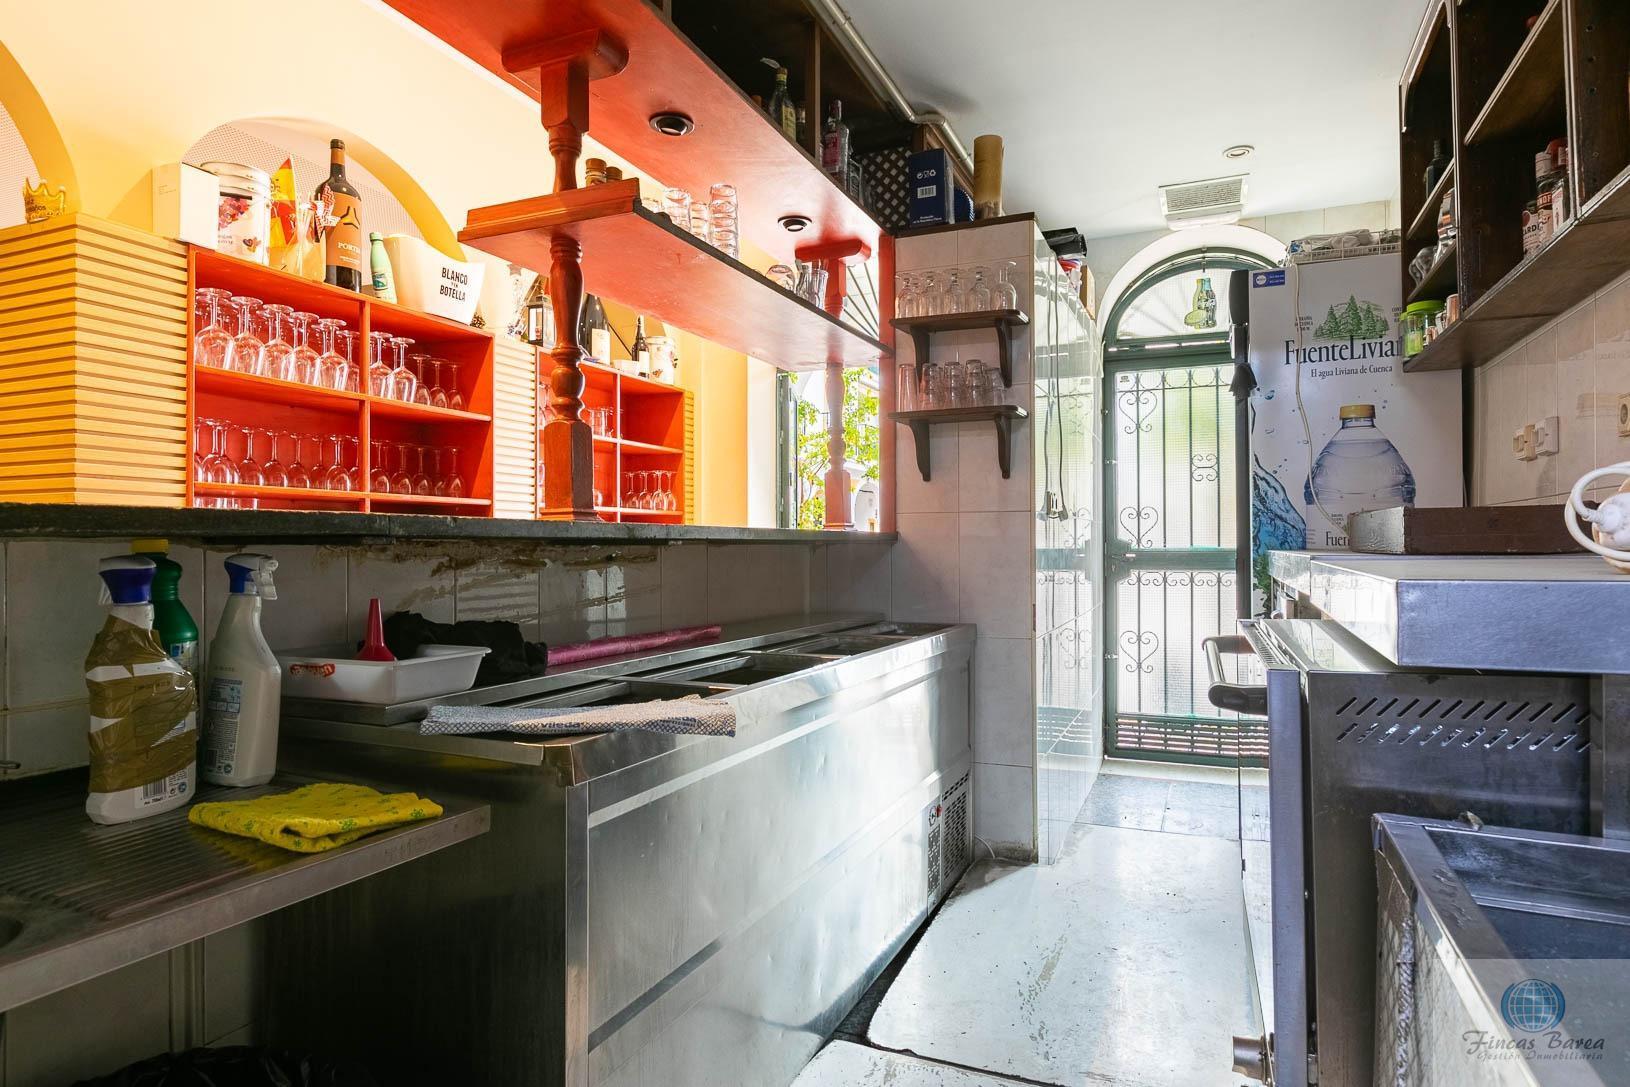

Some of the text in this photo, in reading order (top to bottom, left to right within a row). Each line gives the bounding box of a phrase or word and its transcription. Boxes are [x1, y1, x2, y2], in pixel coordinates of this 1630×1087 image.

[441, 267, 468, 285] BLANCO
[439, 284, 466, 301] BOTELLA
[1311, 364, 1393, 380] El agua Liviana de Cuenca
